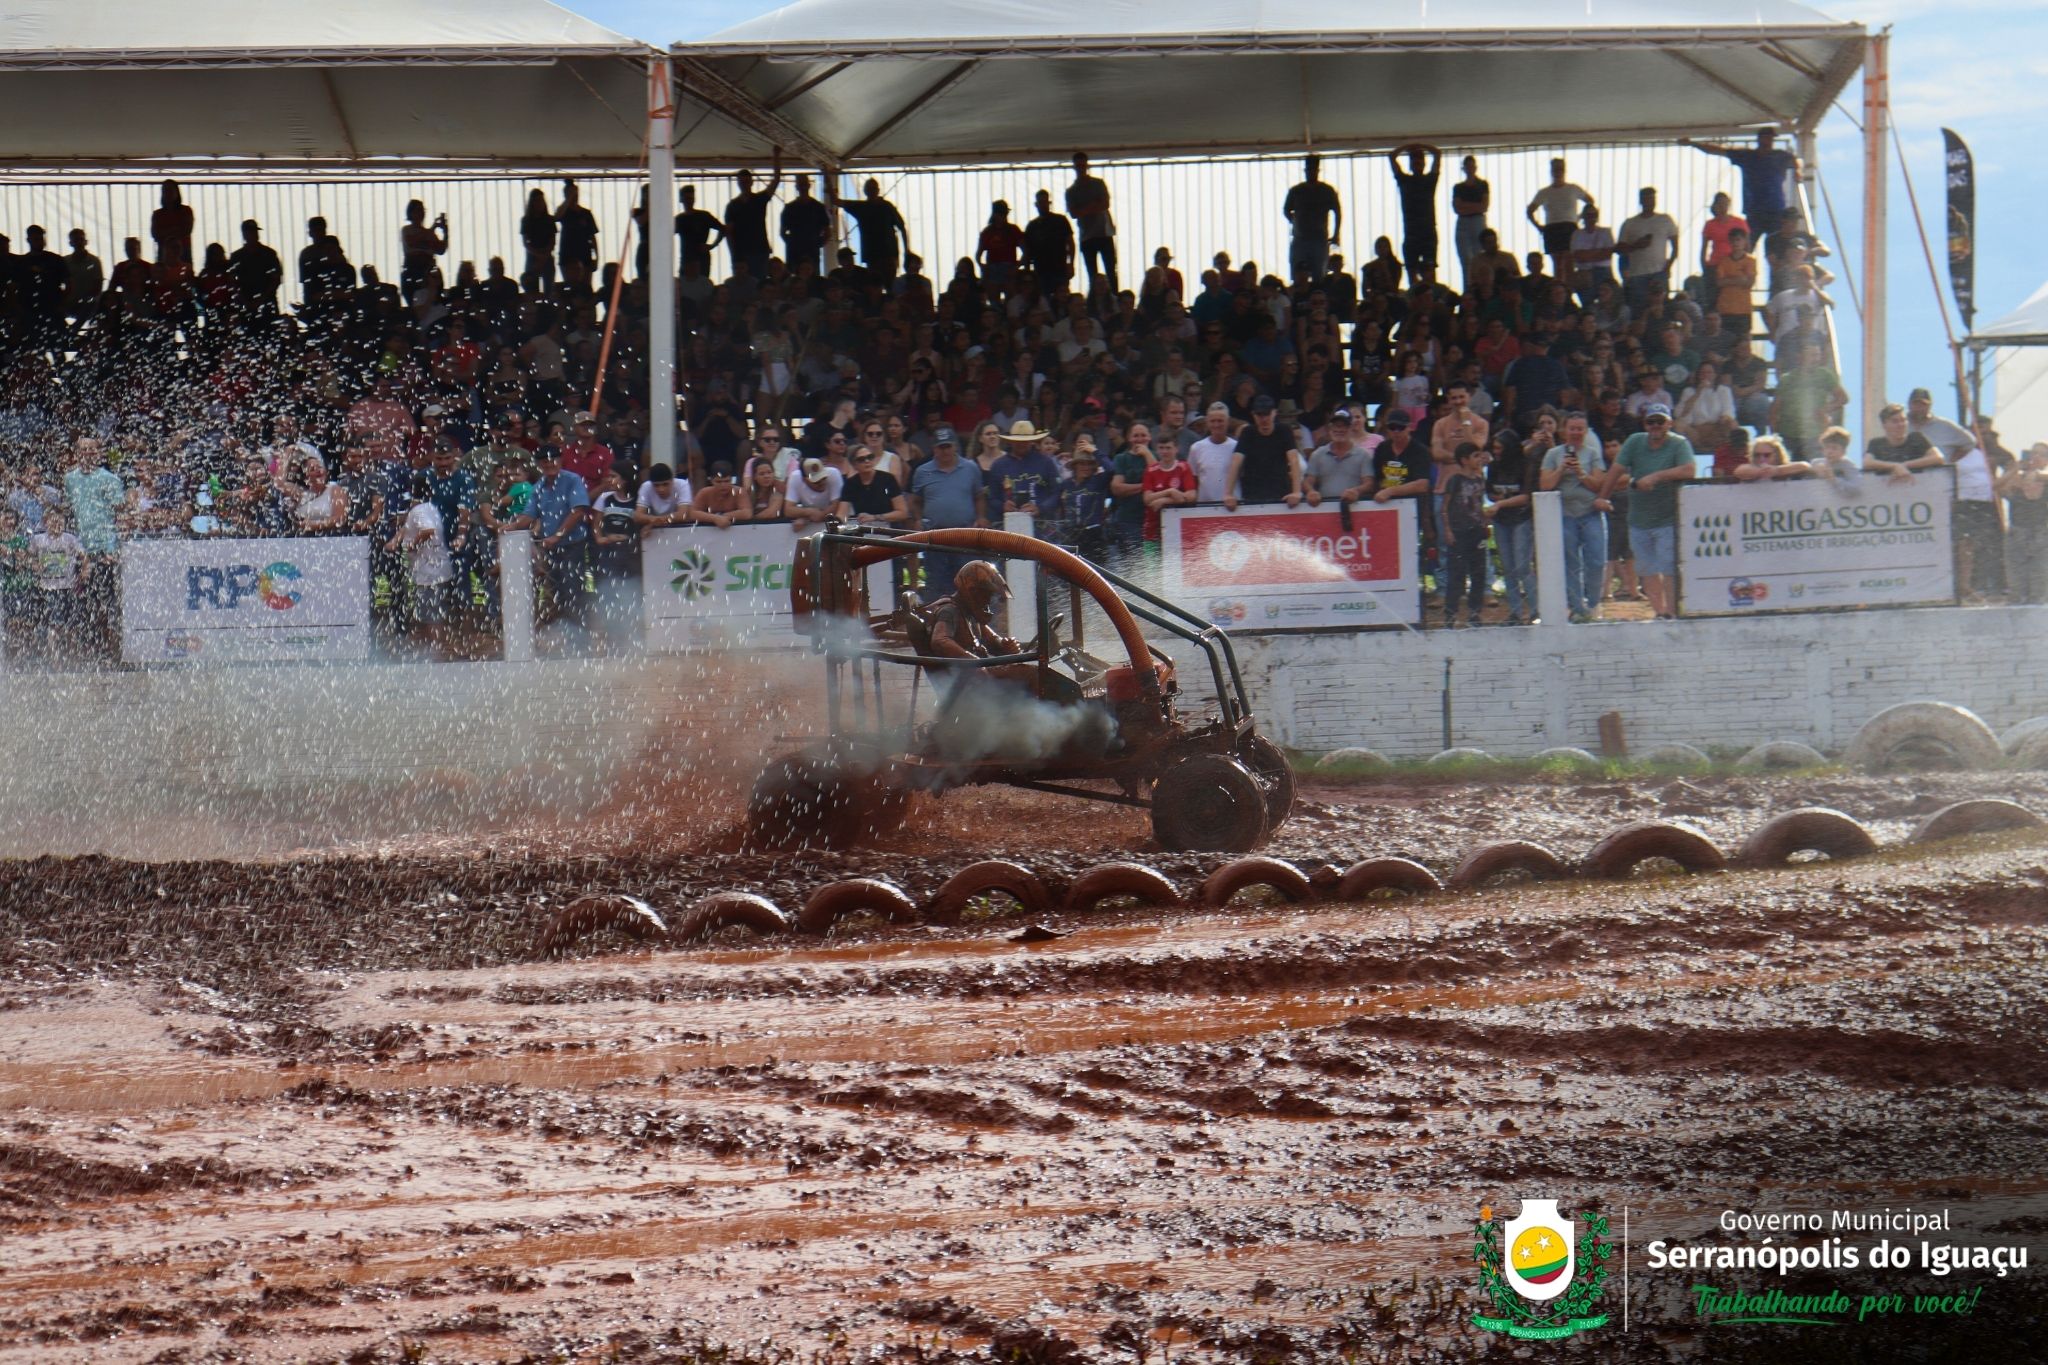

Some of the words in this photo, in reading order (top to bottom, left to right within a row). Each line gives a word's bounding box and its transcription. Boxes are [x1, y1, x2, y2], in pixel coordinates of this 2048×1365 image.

[1742, 502, 1932, 535] IRRIGASSOLO
[1743, 540, 1804, 553] SISTEMAS
[1806, 538, 1823, 550] DE
[1826, 531, 1897, 549] IRRIGAÇÃO
[187, 561, 303, 611] RPC
